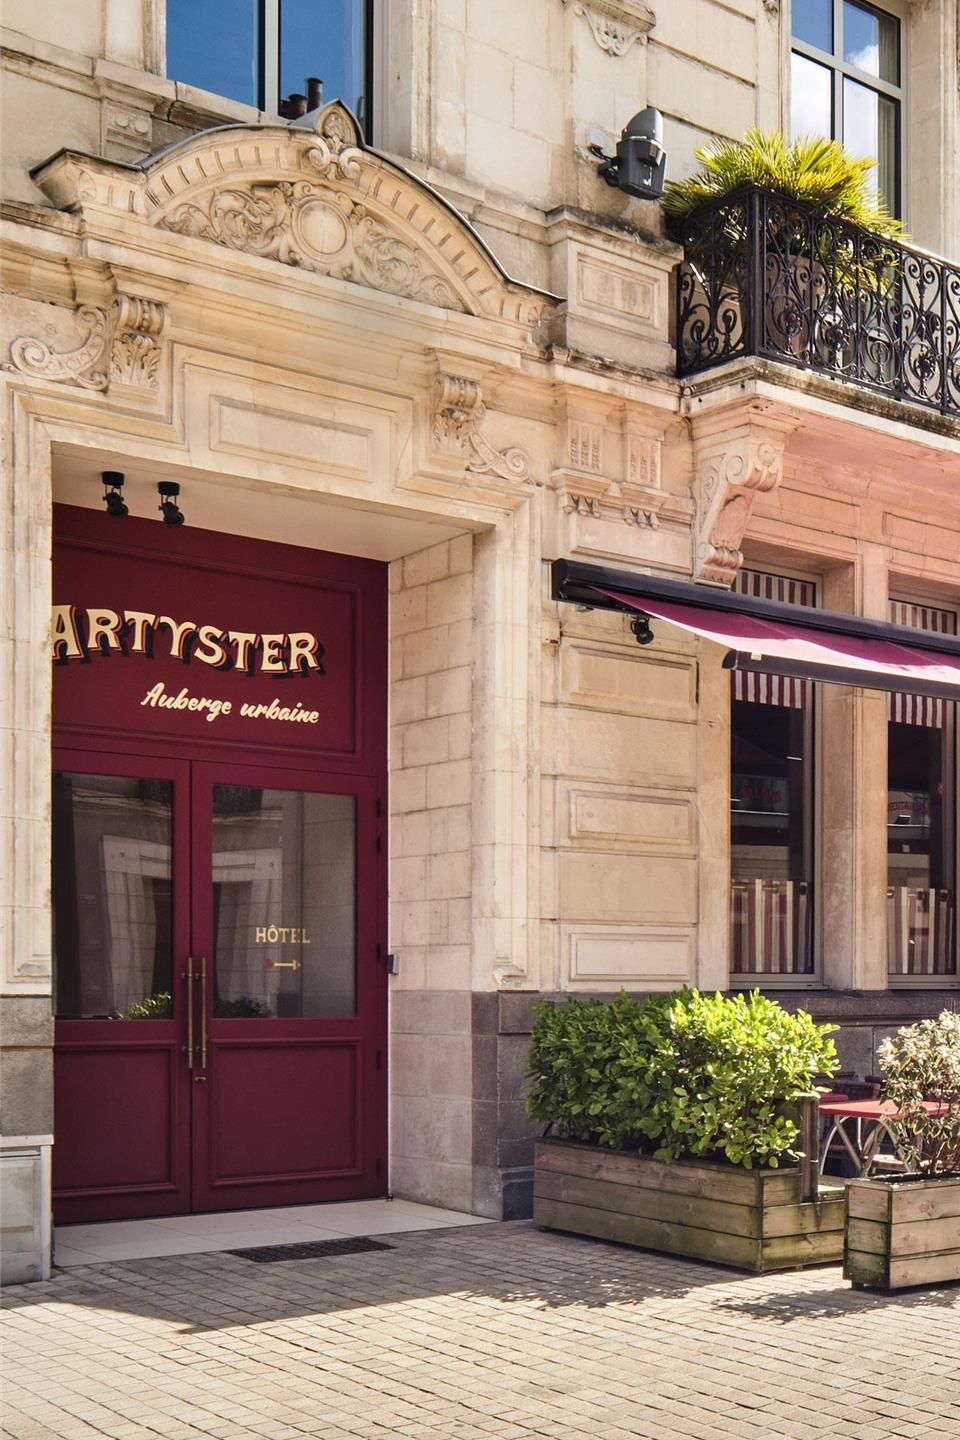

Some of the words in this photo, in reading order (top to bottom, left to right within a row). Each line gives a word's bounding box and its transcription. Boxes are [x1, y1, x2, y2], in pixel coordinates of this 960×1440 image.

[51, 604, 321, 674] ARTYSTER
[140, 682, 232, 722] Auberge
[239, 698, 320, 724] urbaine
[255, 924, 311, 944] HÔTEL
